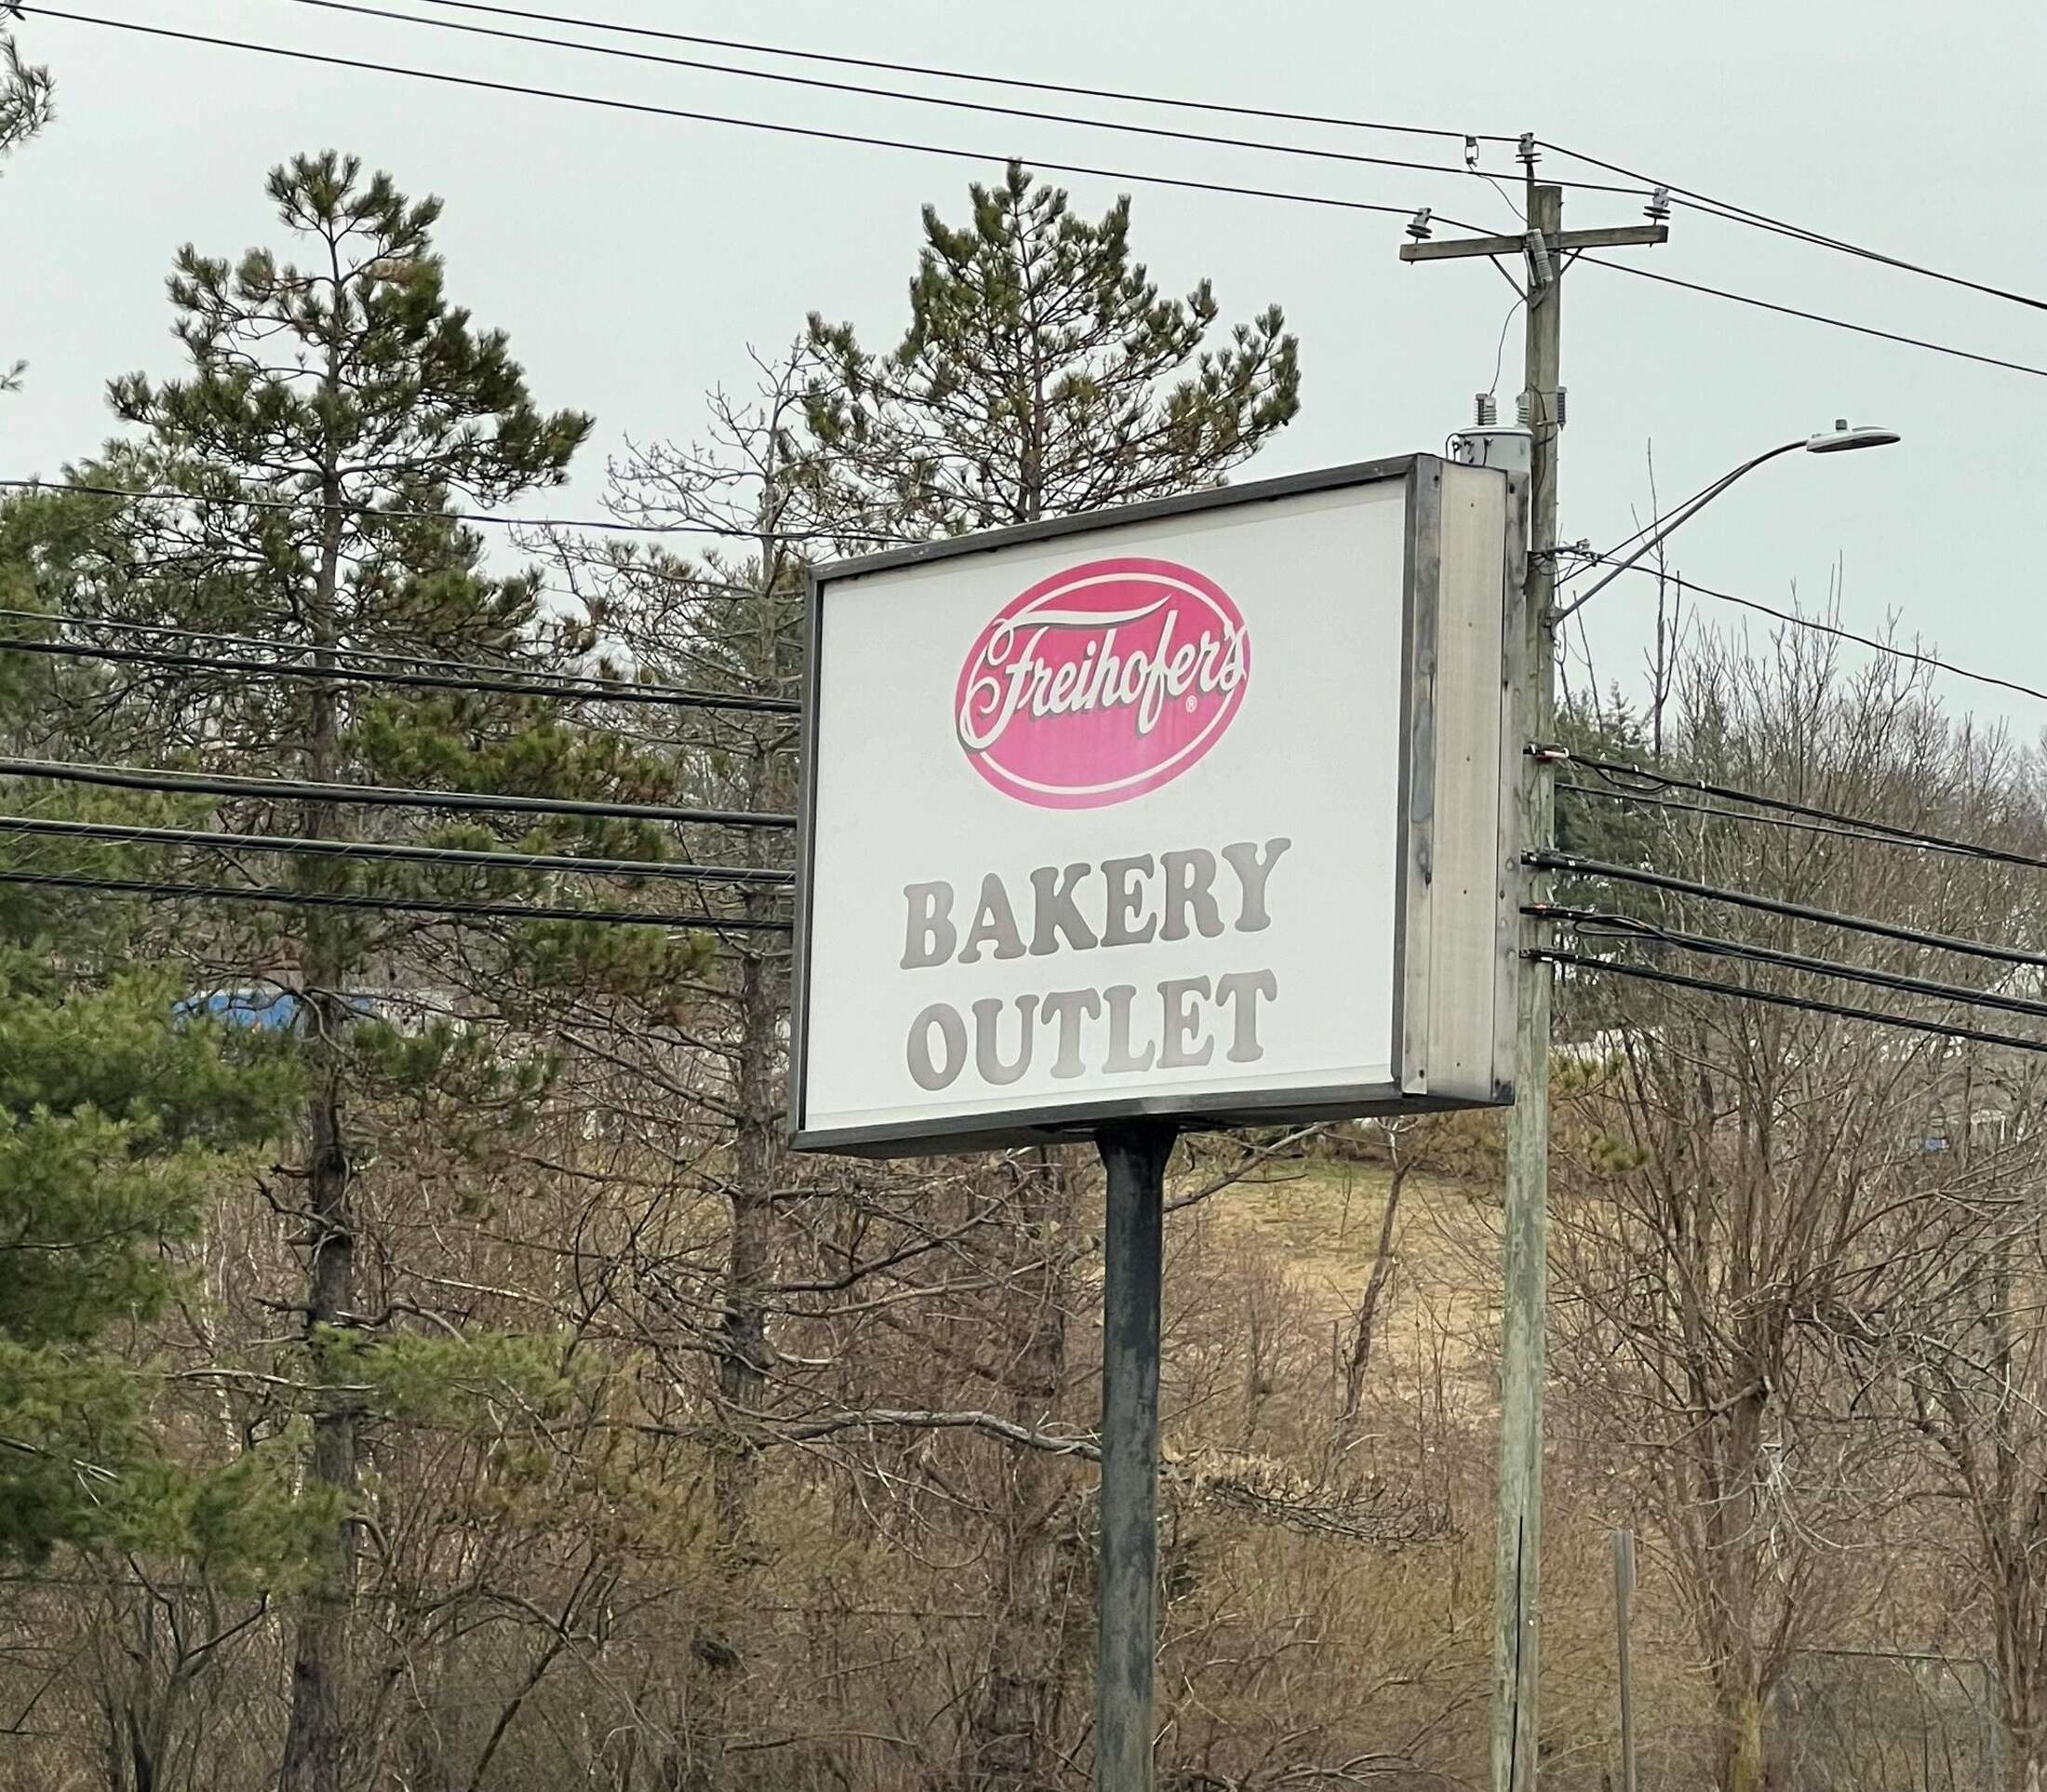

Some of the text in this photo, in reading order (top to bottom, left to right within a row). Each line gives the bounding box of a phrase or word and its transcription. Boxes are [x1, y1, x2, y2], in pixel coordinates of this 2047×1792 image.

[957, 594, 1248, 750] Freihofer's
[900, 838, 1291, 970] BAKERY
[906, 970, 1278, 1091] OUTLET
